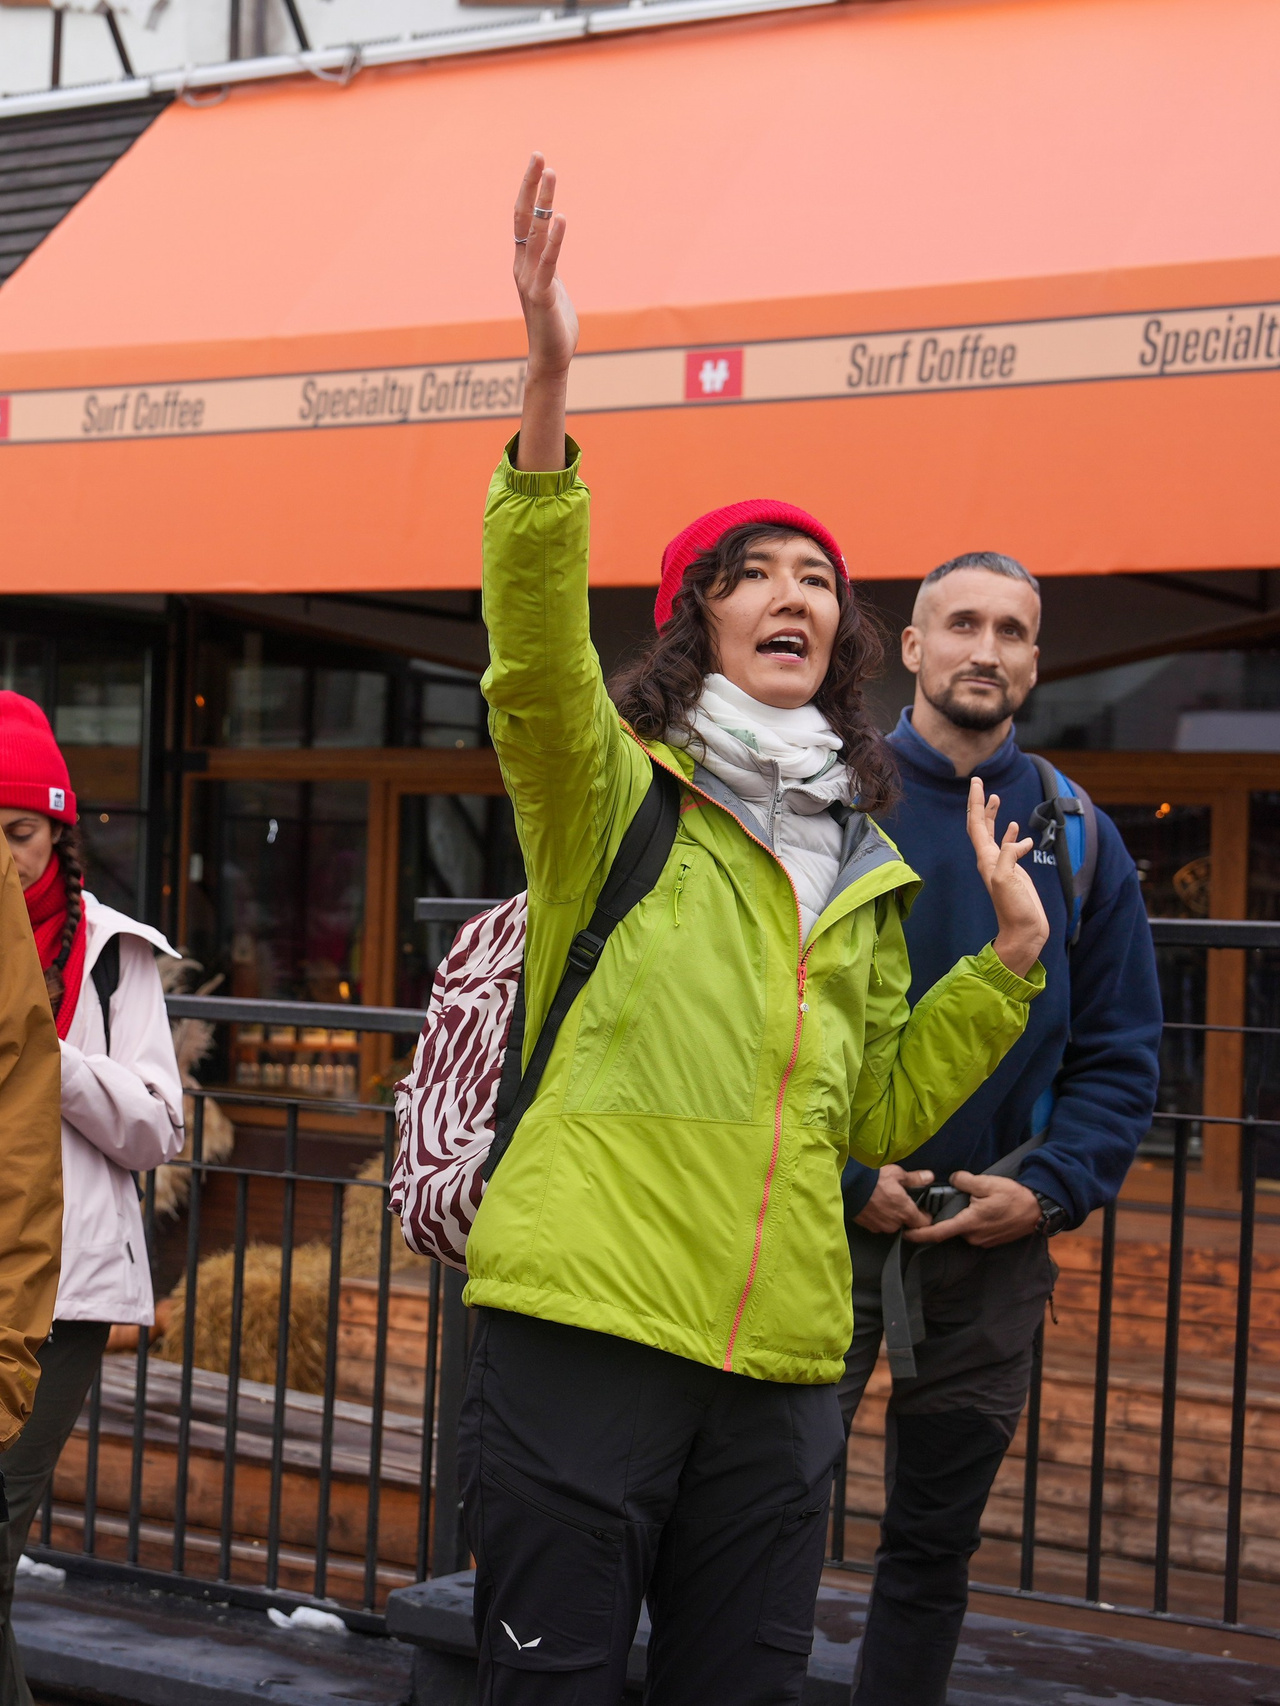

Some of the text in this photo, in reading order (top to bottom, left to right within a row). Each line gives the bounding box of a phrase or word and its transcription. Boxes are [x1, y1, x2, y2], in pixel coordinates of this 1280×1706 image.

[847, 333, 1017, 388] Surf Coffee
[1139, 310, 1280, 375] Specialt
[82, 390, 206, 434] Surf Coffee
[299, 367, 527, 428] Specialty Coffeesh
[1033, 849, 1057, 866] Ric
